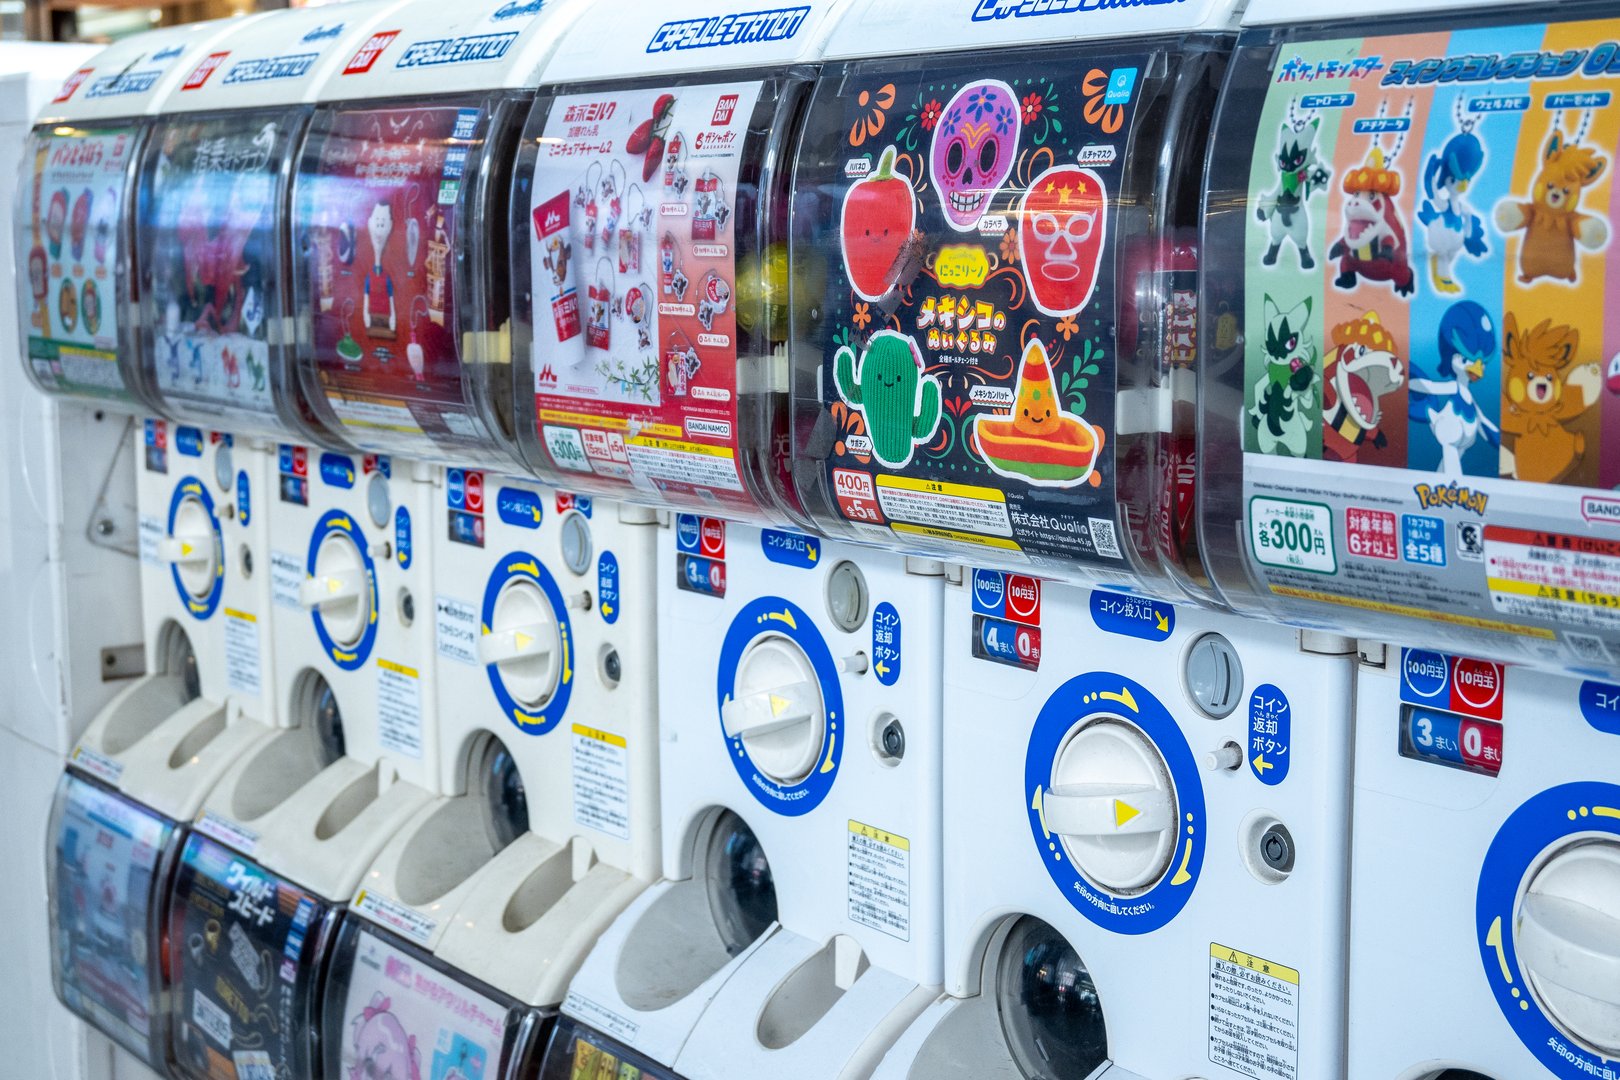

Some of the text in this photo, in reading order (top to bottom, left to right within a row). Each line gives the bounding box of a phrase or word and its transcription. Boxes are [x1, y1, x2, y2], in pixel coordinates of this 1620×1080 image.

[1276, 54, 1384, 83] ポケットモンスター
[1380, 50, 1589, 86] スイングコレクション
[1107, 90, 1130, 99] Qualia
[563, 102, 617, 123] 森永ミルク
[1081, 150, 1113, 160] ルチャマスク
[983, 220, 1003, 230] カラベラ
[916, 294, 1007, 332] メキシコの
[926, 327, 998, 355] ぬいぐるみ
[938, 354, 979, 366] 全種ボールチェーン付き
[973, 389, 1010, 401] メキシカンハット
[687, 421, 708, 431] BANDAI
[707, 423, 729, 434] NAMCO
[850, 438, 867, 449] サボテン
[837, 473, 870, 492] 400円
[1348, 516, 1394, 535] 対象年齢
[1350, 532, 1396, 559] 6才以上
[1405, 543, 1444, 564] 全5種
[976, 579, 1002, 594] 100円玉
[1011, 586, 1036, 601] 10円玉
[875, 612, 900, 626] コイン
[1099, 599, 1153, 622] コイン投入口
[875, 629, 893, 646] 返却
[875, 645, 900, 661] ボタン
[1407, 660, 1445, 680] 100円玉
[1459, 670, 1495, 690] 10円玉
[1253, 695, 1289, 714] コイン
[1253, 715, 1278, 736] 返却
[1253, 736, 1288, 757] ボタン
[1073, 881, 1156, 916] 矢印の方向に回してください。
